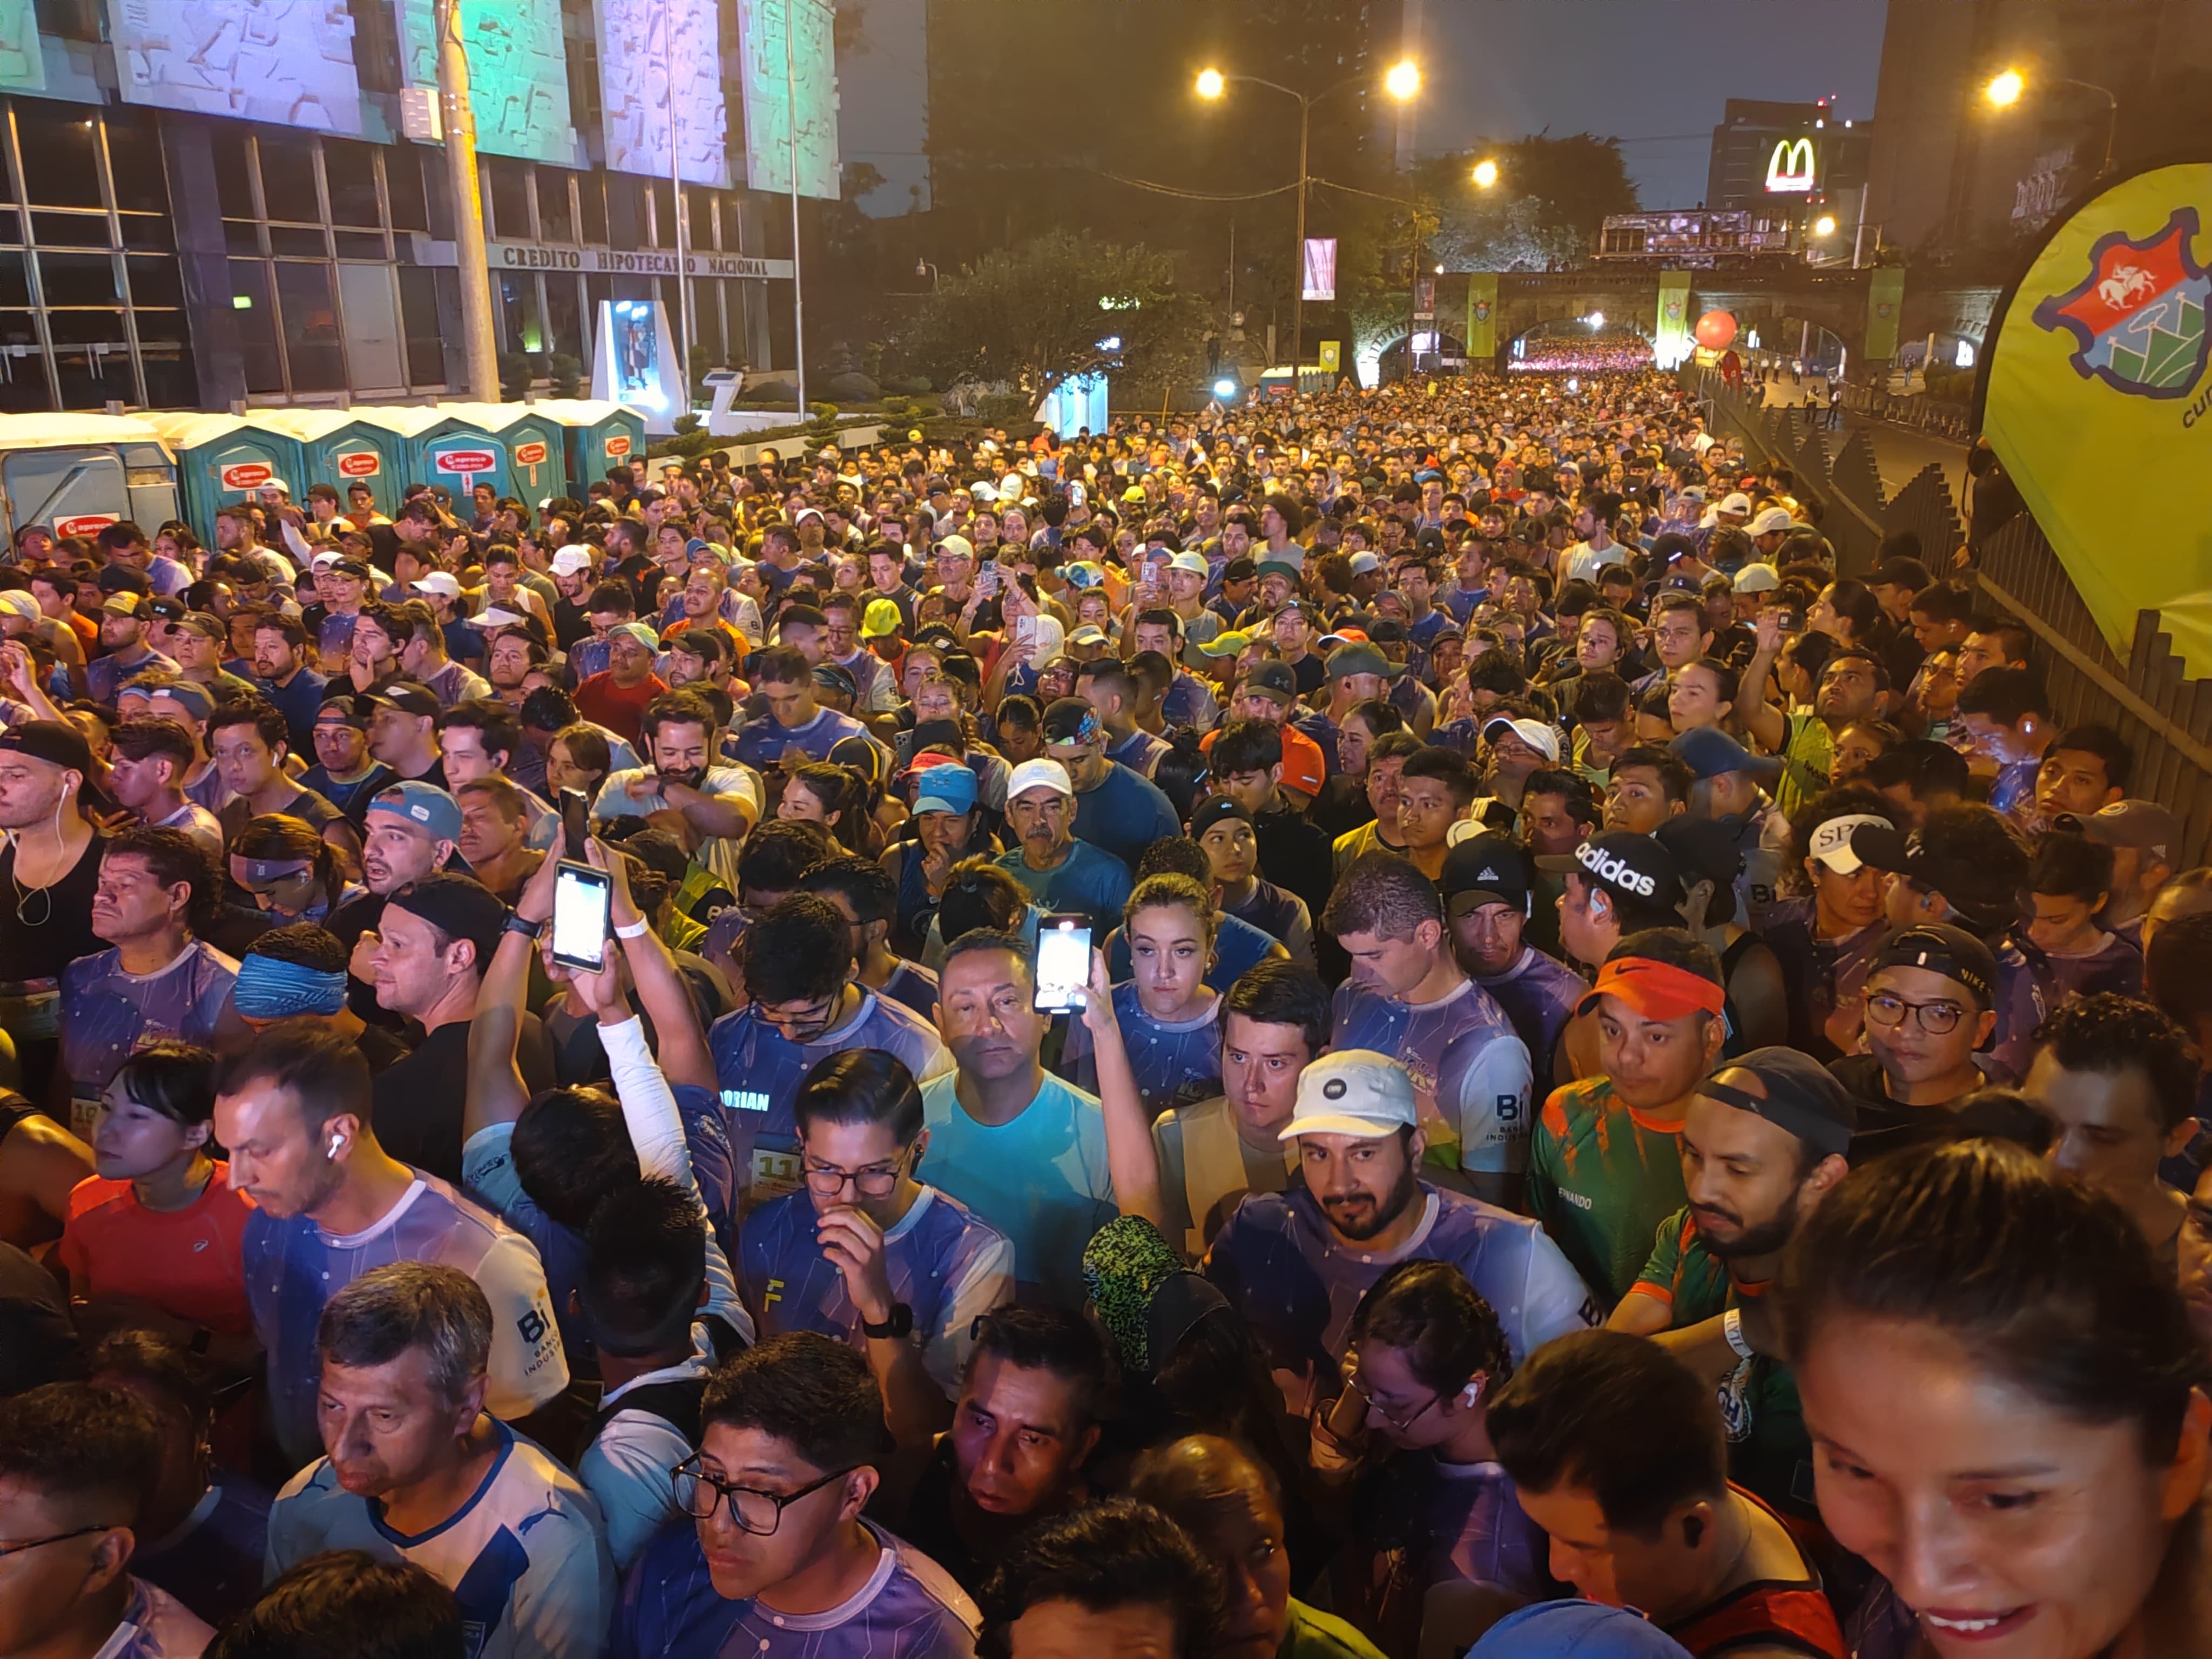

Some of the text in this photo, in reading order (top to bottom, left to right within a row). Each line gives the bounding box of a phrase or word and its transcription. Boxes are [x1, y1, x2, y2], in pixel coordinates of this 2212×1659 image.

[503, 248, 581, 268] CREDITO
[709, 258, 768, 275] NACIONAL
[1575, 842, 1655, 896] adidas
[1496, 1092, 1523, 1121] Bi
[516, 1300, 551, 1344] Bi
